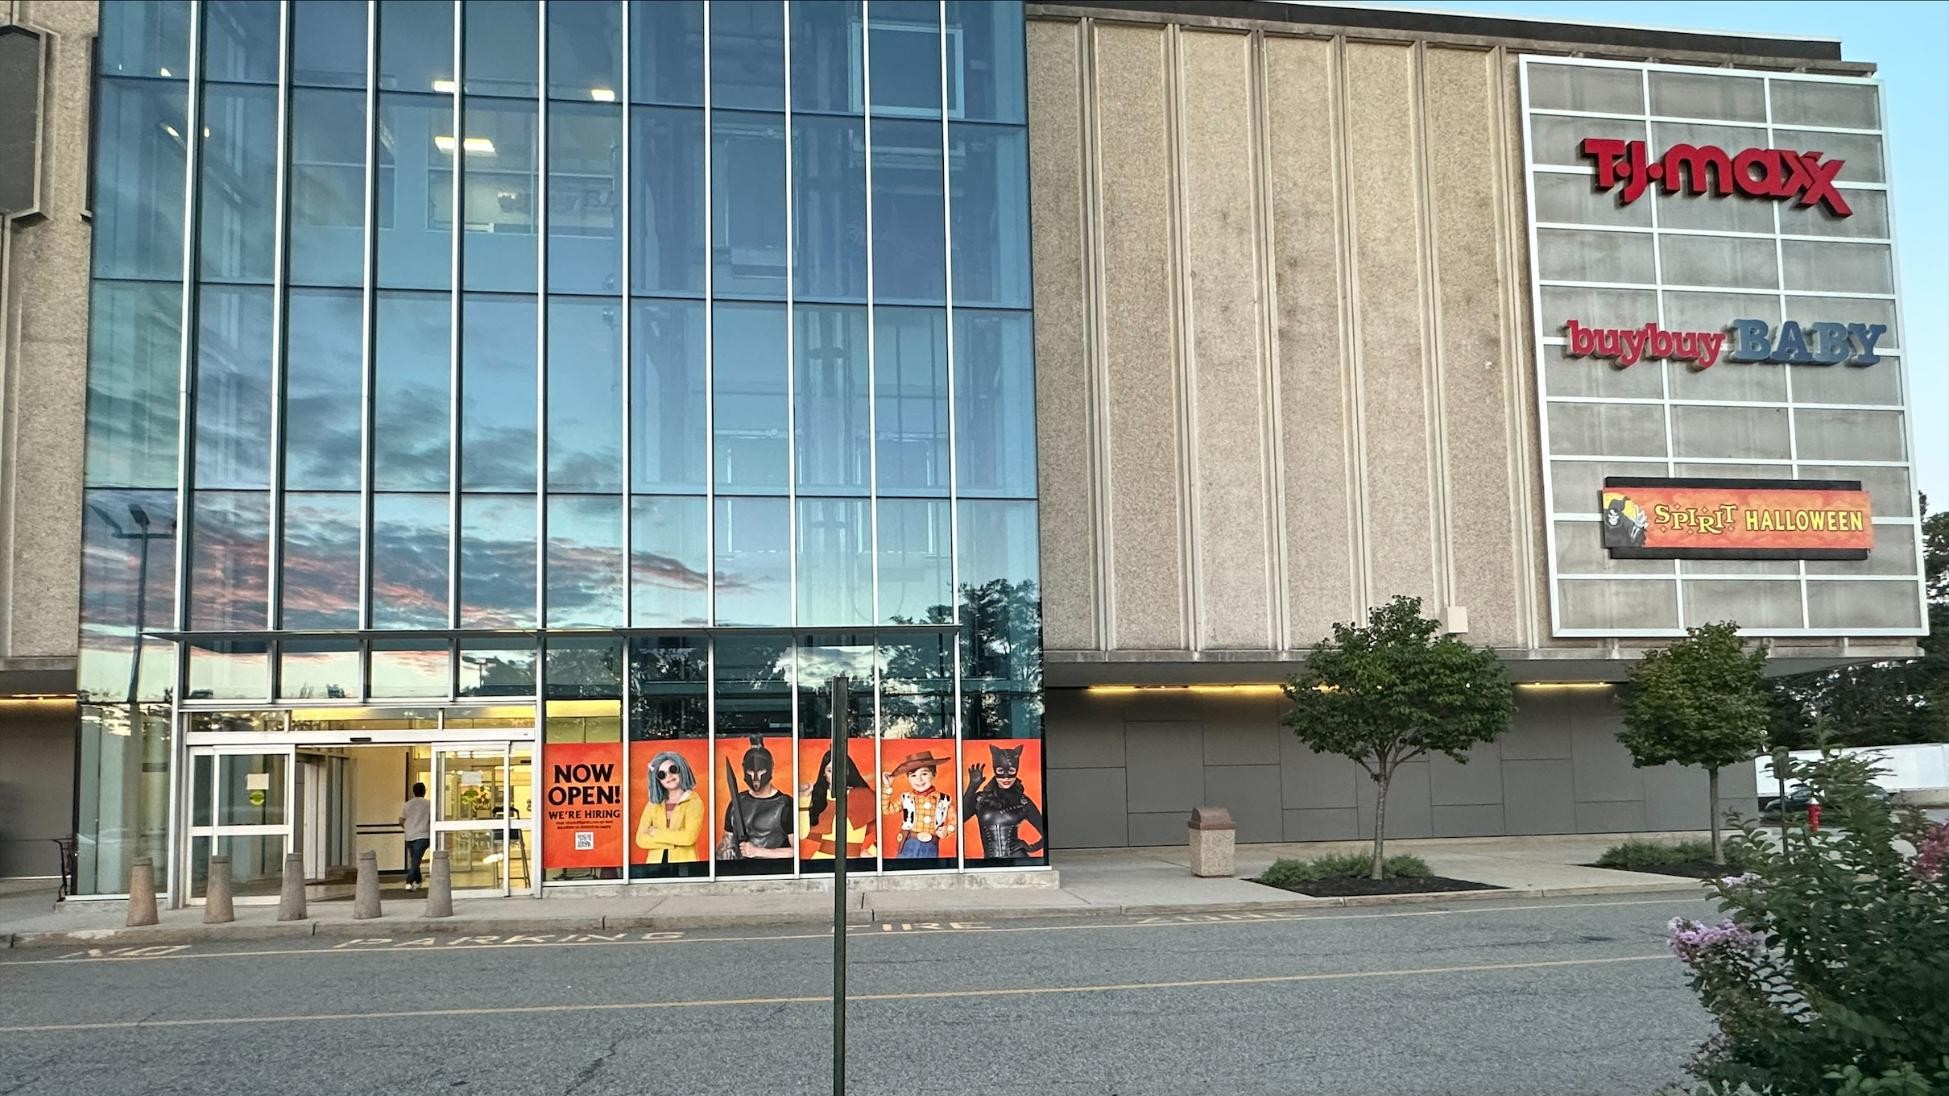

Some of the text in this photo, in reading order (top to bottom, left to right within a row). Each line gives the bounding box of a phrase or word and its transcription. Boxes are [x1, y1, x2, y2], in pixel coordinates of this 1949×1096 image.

[1566, 319, 1887, 370] buybuy BABY
[1654, 503, 1864, 535] SPIRIT HALLOWEEN
[554, 764, 614, 783] NOW
[548, 786, 621, 805] OPEN!
[548, 810, 620, 820] WE'RE HIRING
[333, 932, 685, 949] PARKING
